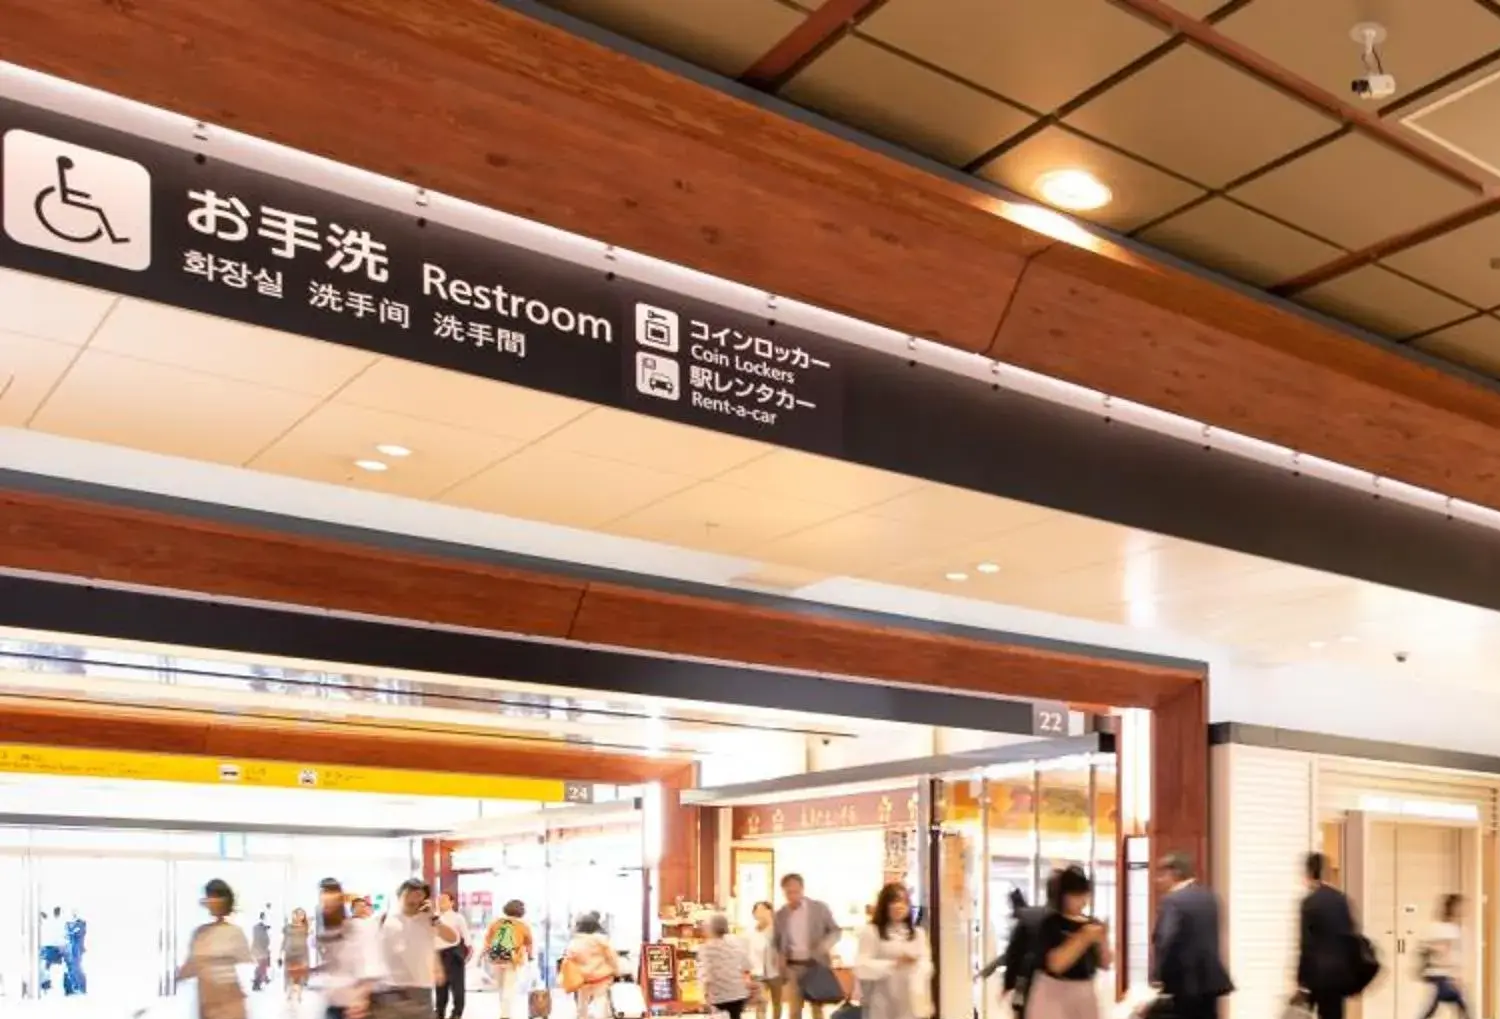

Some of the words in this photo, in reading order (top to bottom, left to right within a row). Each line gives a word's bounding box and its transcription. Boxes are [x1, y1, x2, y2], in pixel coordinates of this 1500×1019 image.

[187, 189, 390, 283] お手洗
[183, 249, 284, 299] 화장실
[308, 280, 411, 329] 洗手间
[423, 262, 613, 343] Restroom
[433, 311, 527, 358] 洗手間
[690, 319, 831, 369] コインロッカー
[689, 364, 817, 410] 駅レンタカー
[690, 344, 730, 368] Coin
[735, 355, 796, 385] Lockers
[691, 390, 778, 426] Rent-a-car
[1040, 711, 1062, 731] 22
